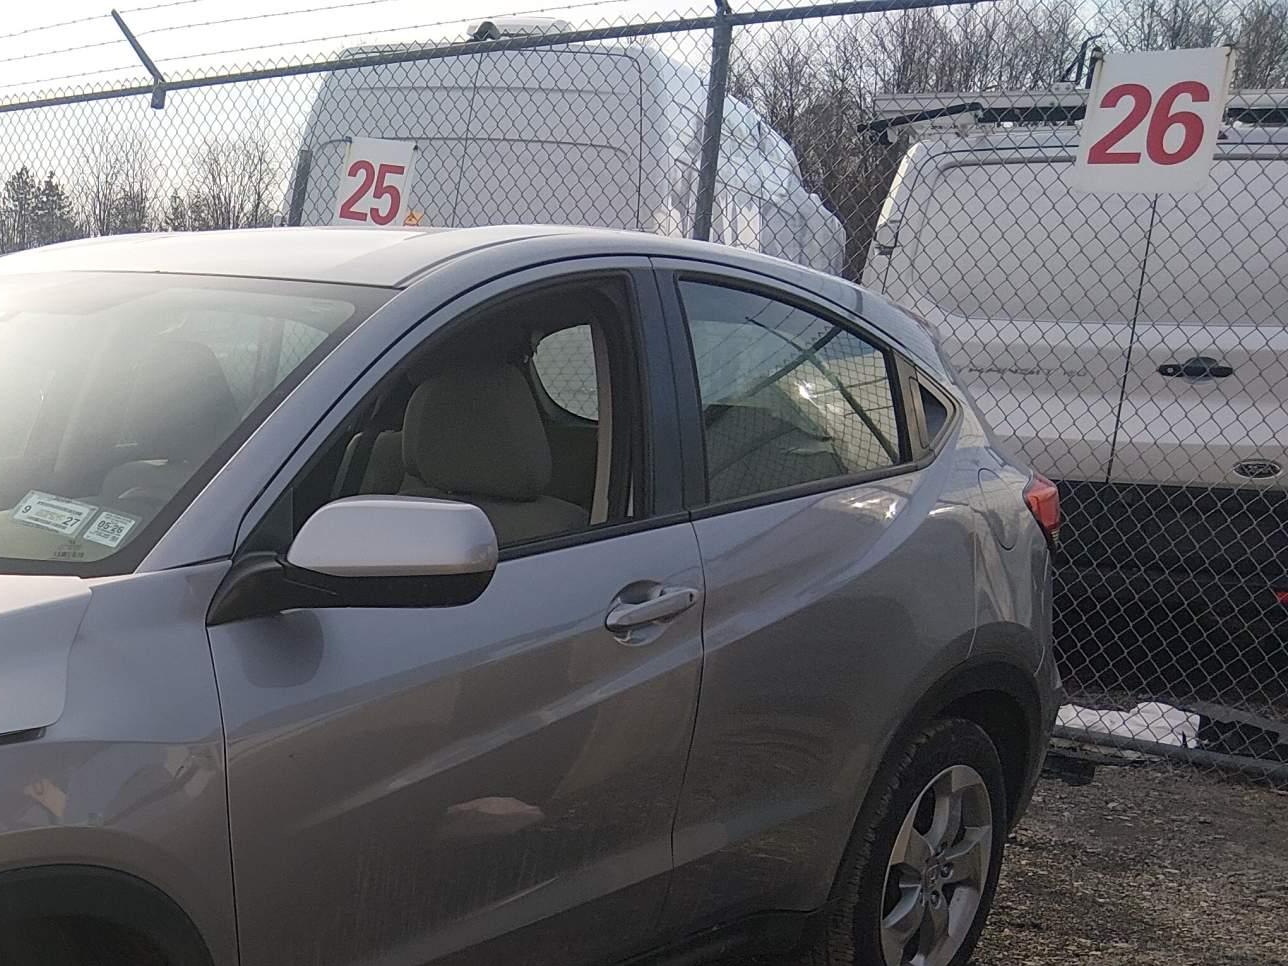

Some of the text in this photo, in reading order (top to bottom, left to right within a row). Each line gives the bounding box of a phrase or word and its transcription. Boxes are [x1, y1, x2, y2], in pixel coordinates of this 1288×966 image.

[1088, 80, 1210, 165] 26
[339, 159, 406, 226] 25
[22, 505, 32, 513] 9
[62, 516, 81, 527] 27
